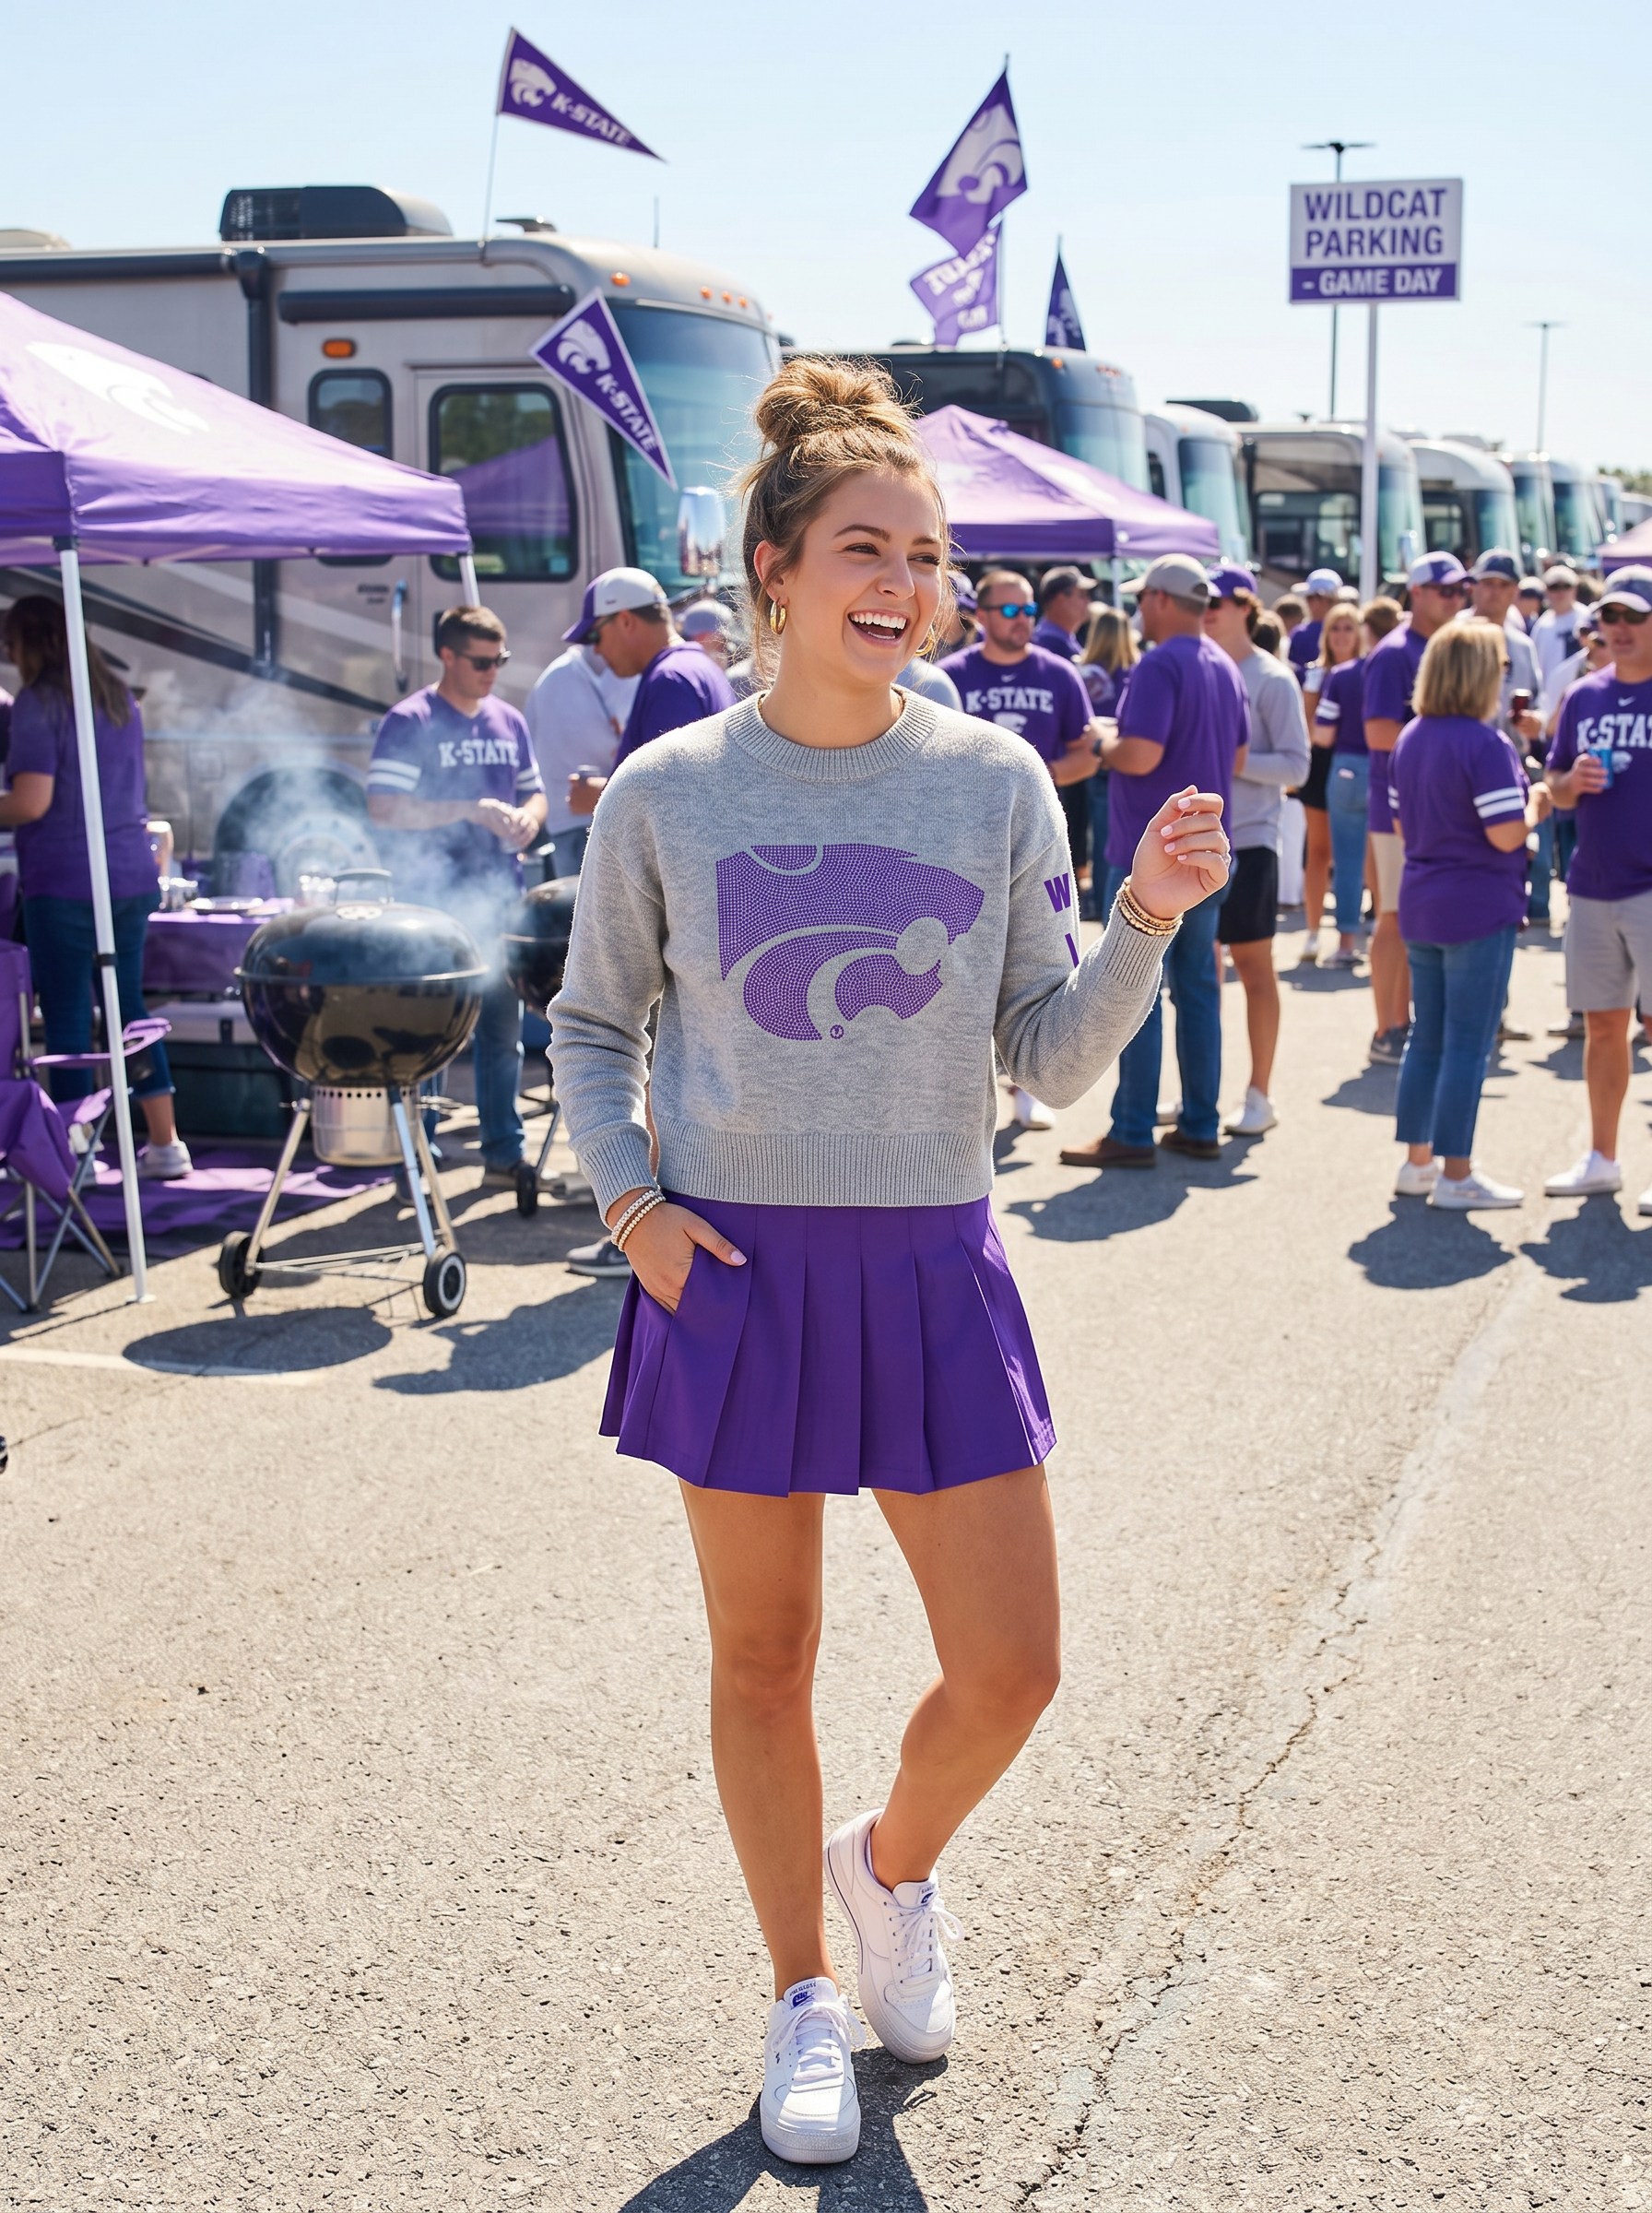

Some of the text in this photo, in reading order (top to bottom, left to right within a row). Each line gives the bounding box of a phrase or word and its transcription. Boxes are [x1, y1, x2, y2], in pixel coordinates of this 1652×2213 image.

[550, 92, 631, 146] K-STATE
[1304, 188, 1446, 221] WILDCAT
[1305, 226, 1443, 259] PARKING
[1318, 268, 1390, 296] GAME
[1394, 266, 1443, 294] DAY
[595, 373, 658, 452] K-STATE
